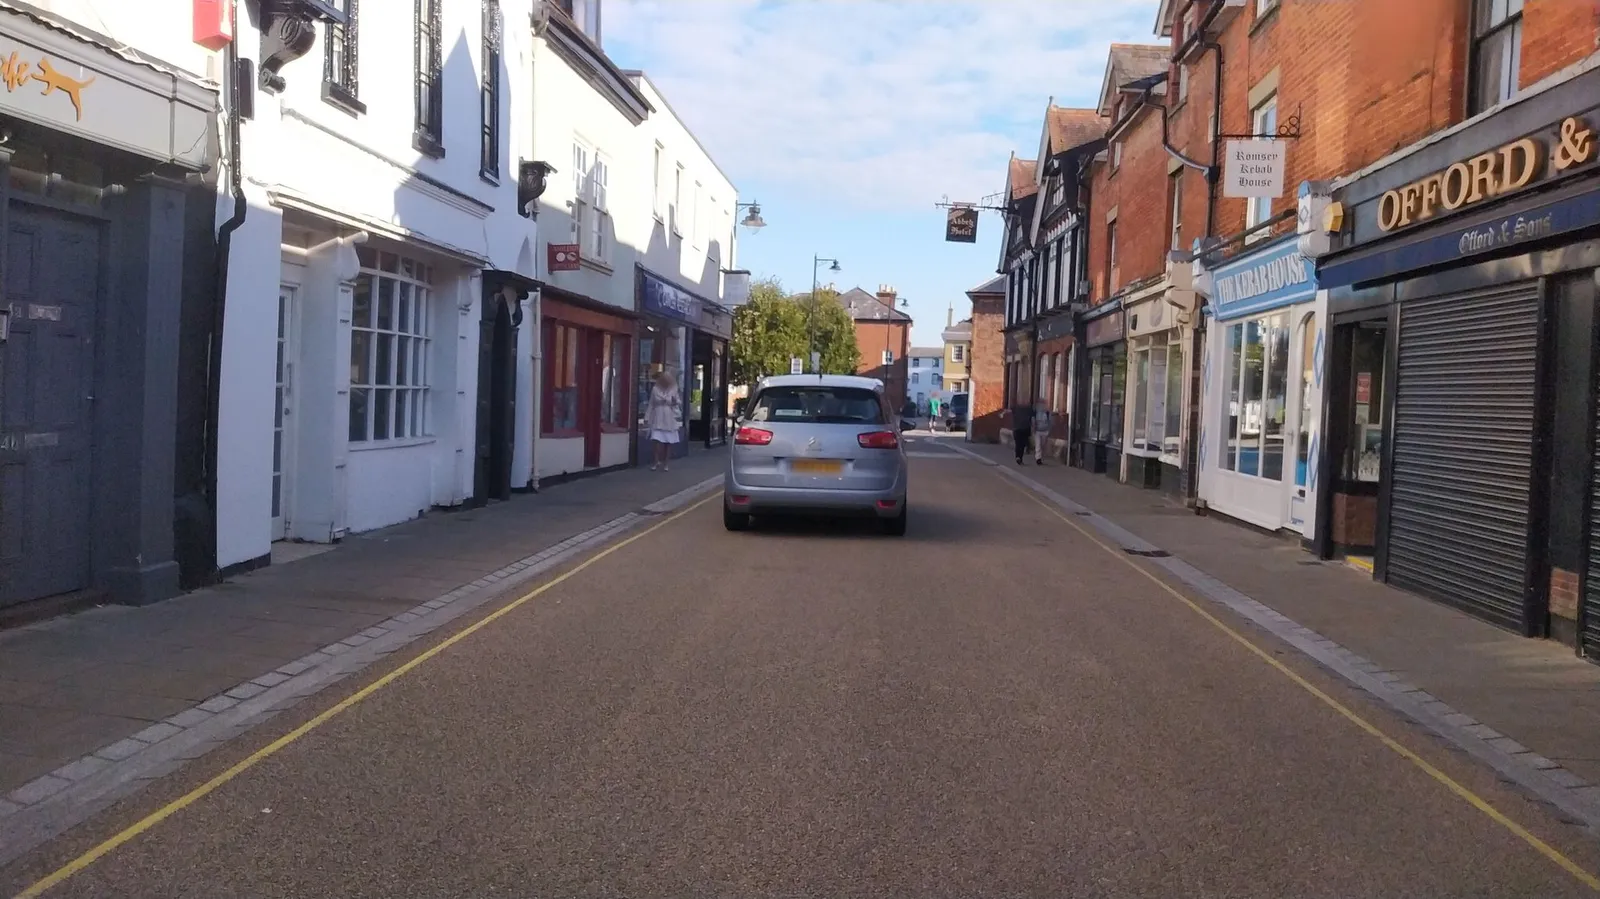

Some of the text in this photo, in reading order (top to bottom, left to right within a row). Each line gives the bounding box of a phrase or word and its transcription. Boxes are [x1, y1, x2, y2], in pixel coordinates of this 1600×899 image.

[1235, 151, 1279, 161] Romsey
[1240, 164, 1272, 174] Kebab
[1377, 117, 1591, 232] OFFORD &
[1239, 177, 1272, 187] House
[950, 217, 974, 228] Abbey
[950, 226, 972, 236] Hotel
[1216, 252, 1308, 305] THE KEBAB HOUSE
